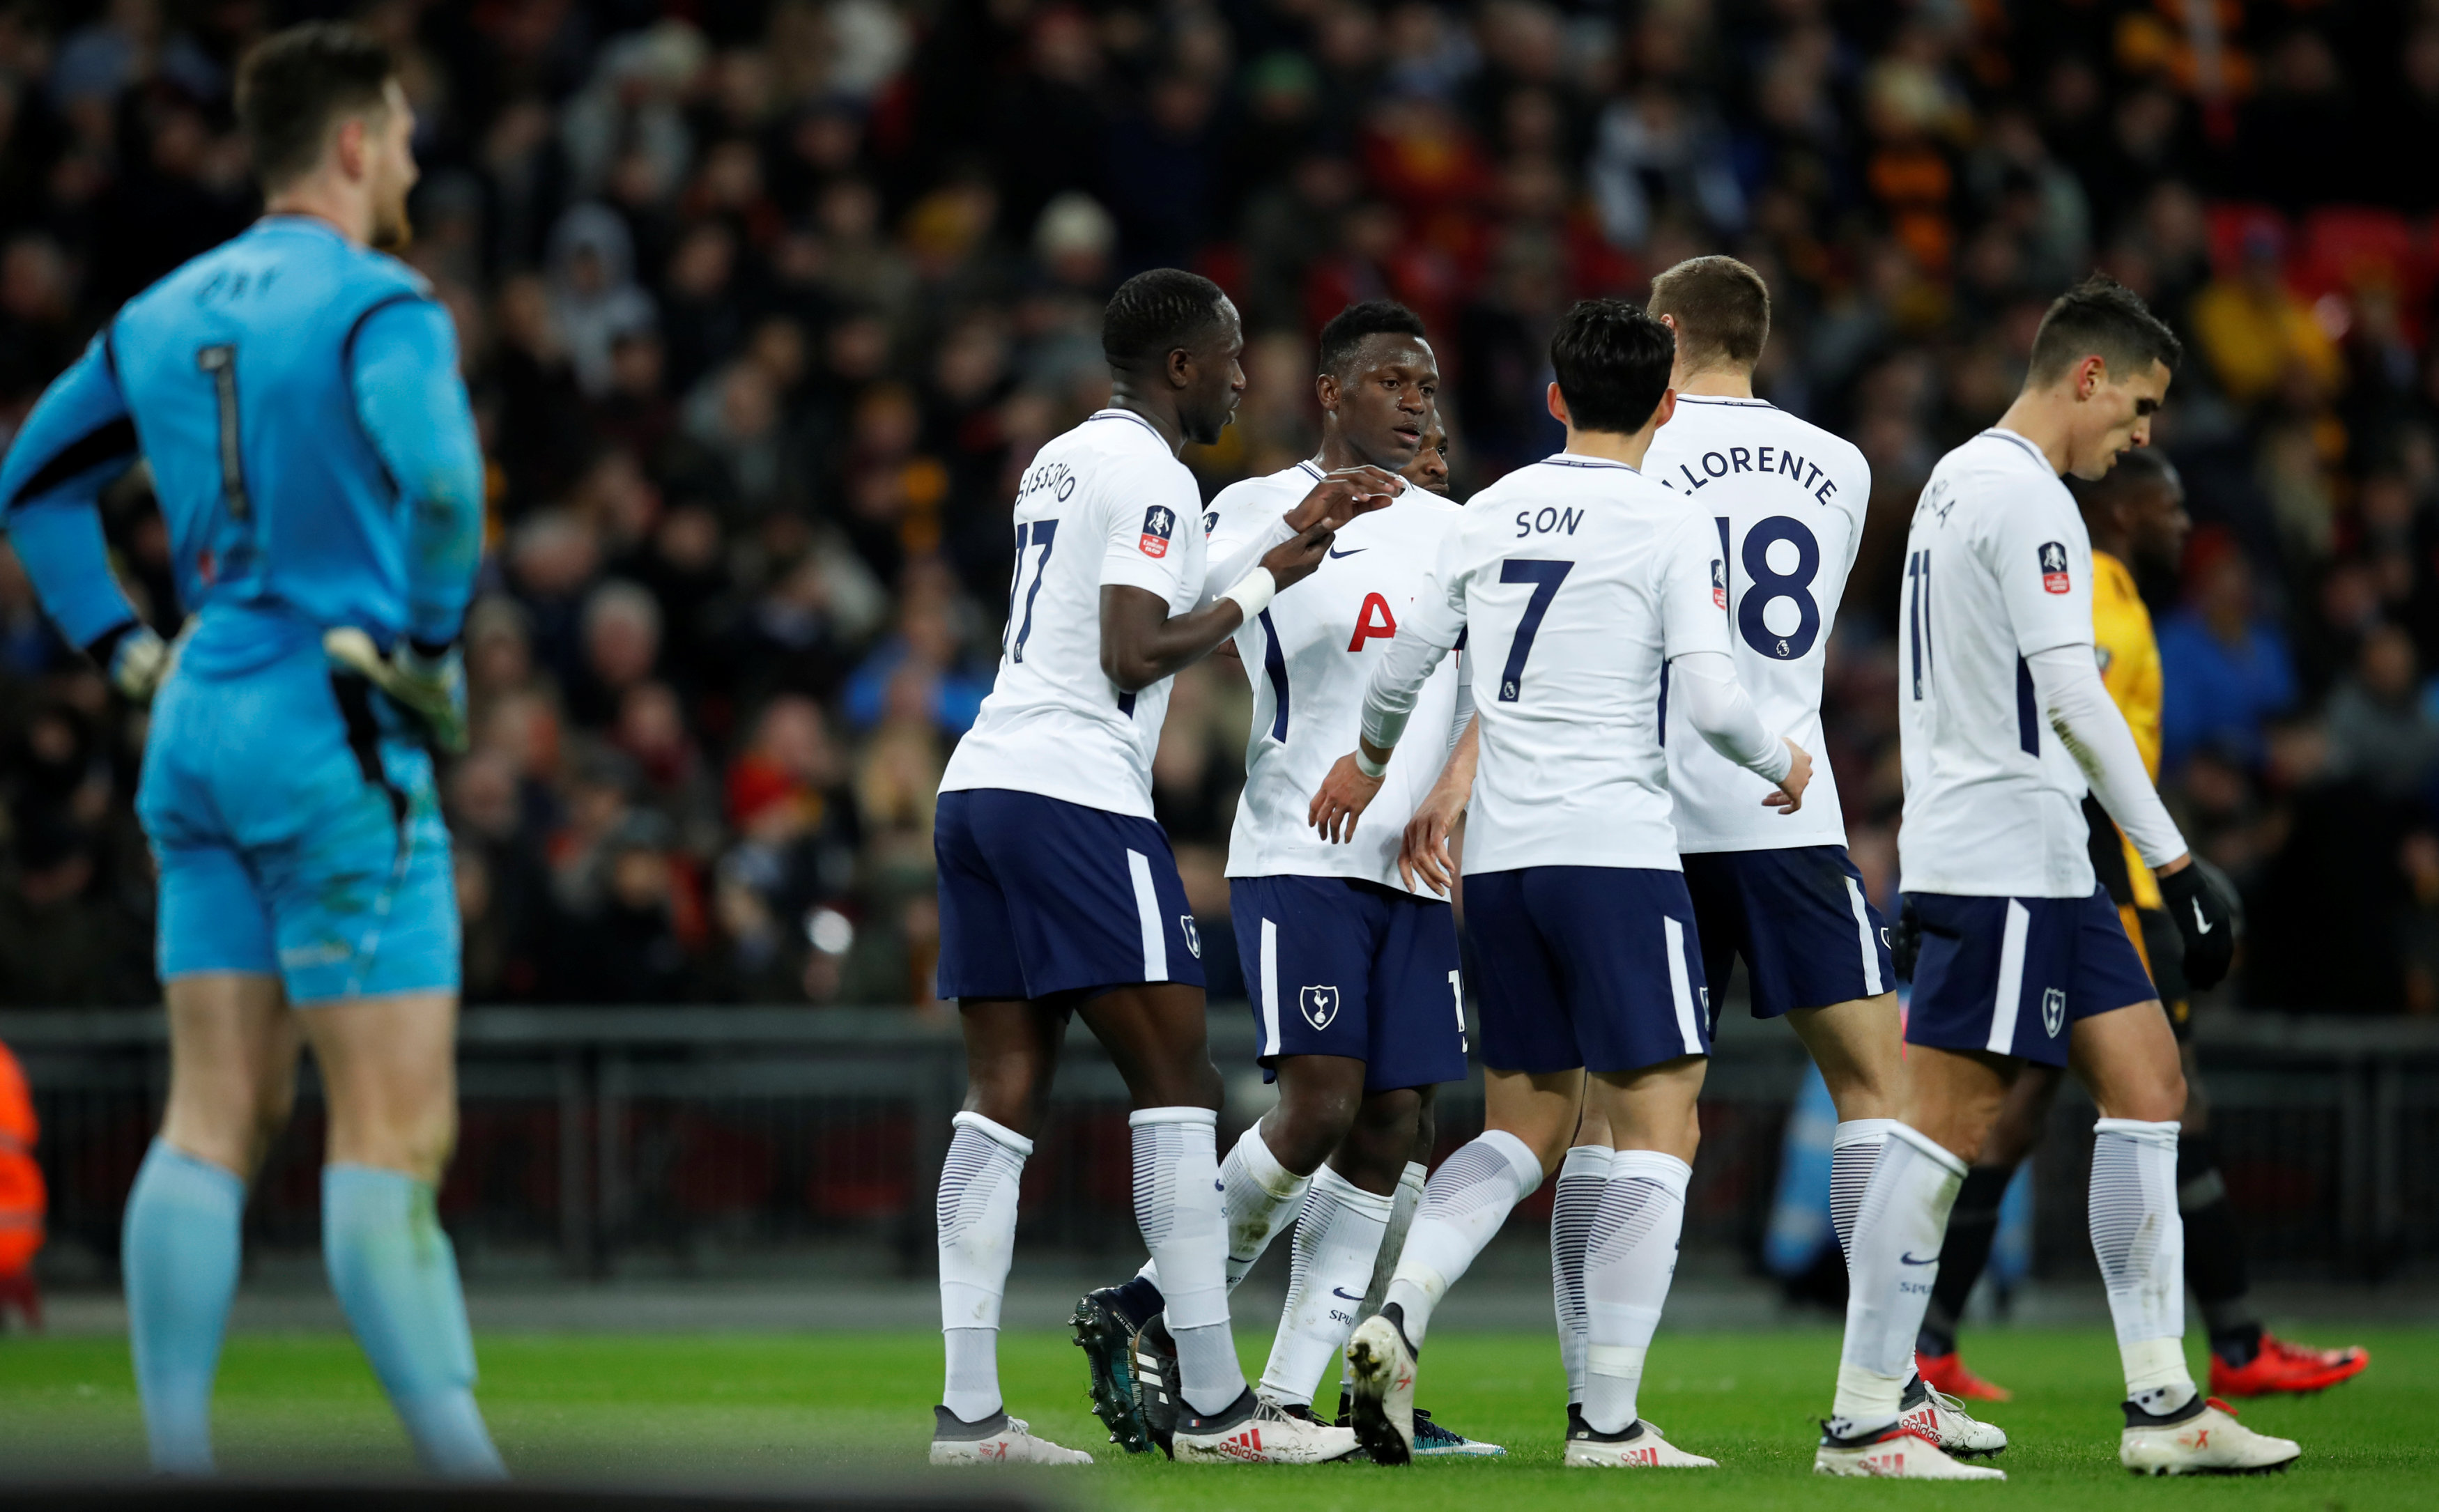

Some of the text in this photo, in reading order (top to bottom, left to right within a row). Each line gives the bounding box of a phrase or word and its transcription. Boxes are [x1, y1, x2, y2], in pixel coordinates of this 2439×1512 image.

[197, 344, 249, 521] 1
[1516, 507, 1584, 538] SON
[1003, 518, 1059, 665] 17
[1498, 559, 1575, 702] 7
[1908, 549, 1935, 701] 11
[1448, 969, 1465, 1033] 1
[1220, 1442, 1268, 1463] adidas
[1902, 1419, 1942, 1443] adidas
